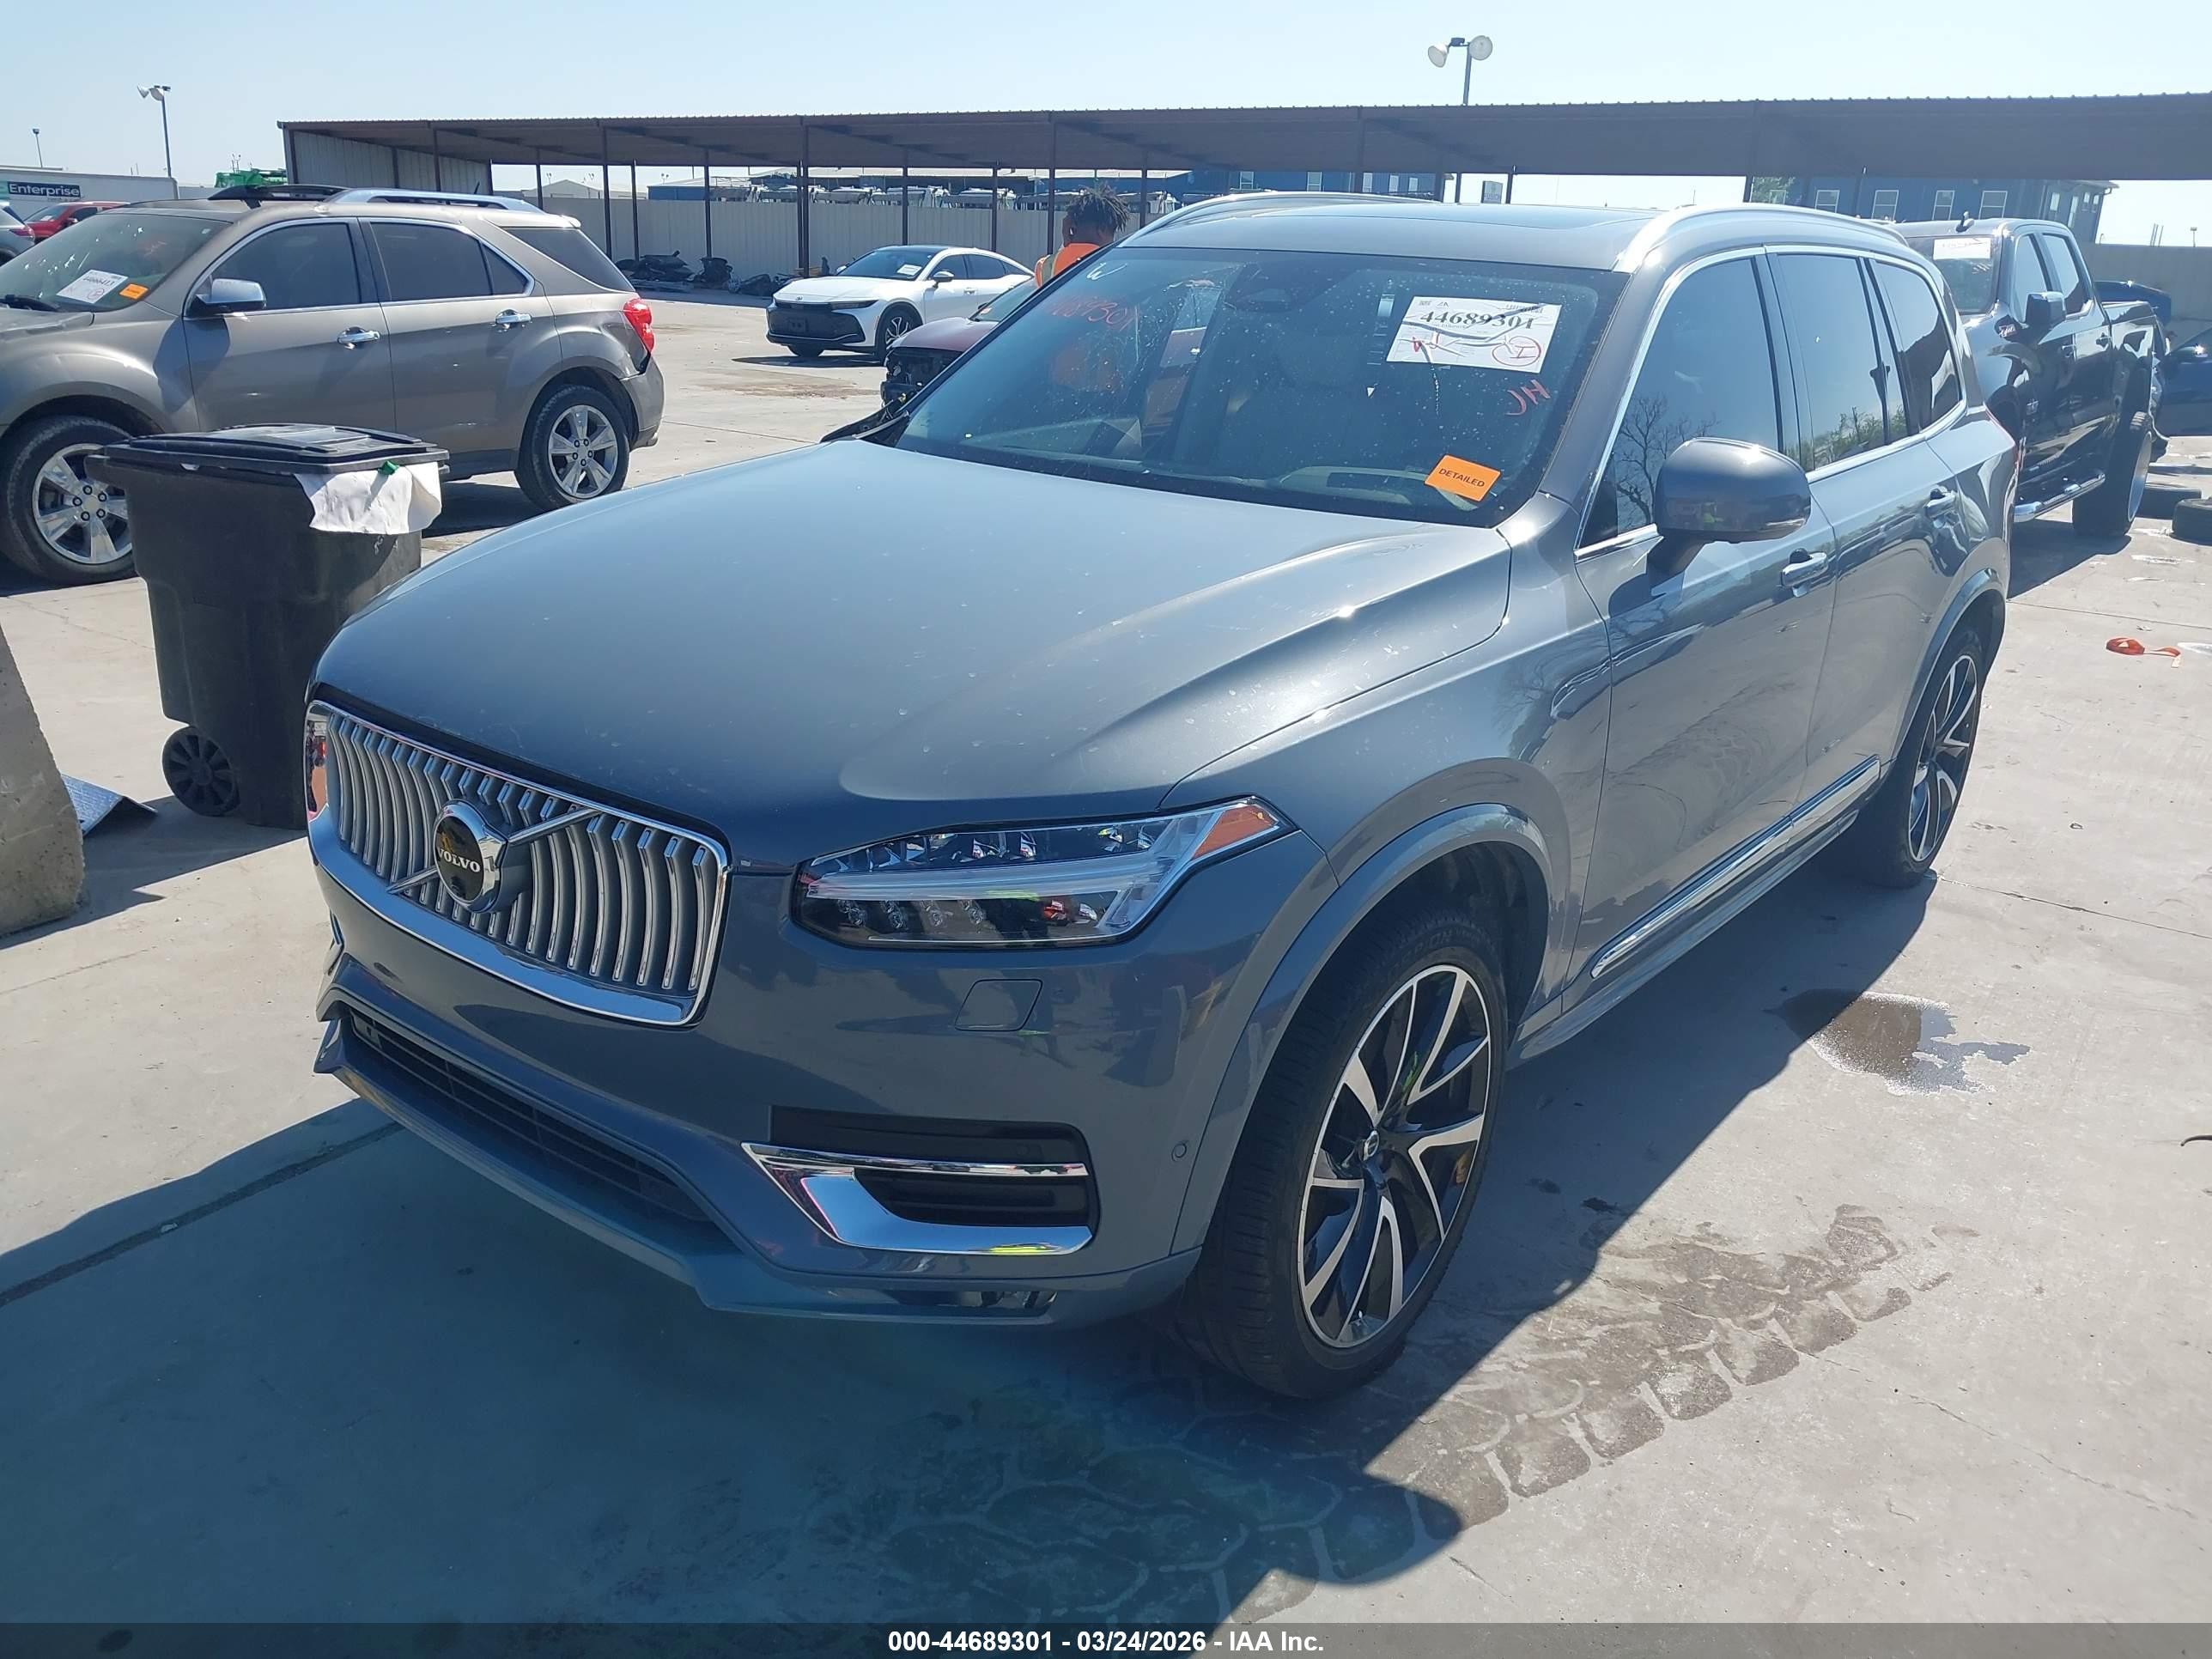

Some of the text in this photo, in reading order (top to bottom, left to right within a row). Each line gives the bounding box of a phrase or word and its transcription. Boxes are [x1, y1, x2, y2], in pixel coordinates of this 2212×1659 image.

[9, 183, 80, 198] Enterprise
[1419, 311, 1535, 330] 44689301
[1438, 468, 1486, 488] DETAILED
[437, 848, 481, 872] VOLVO
